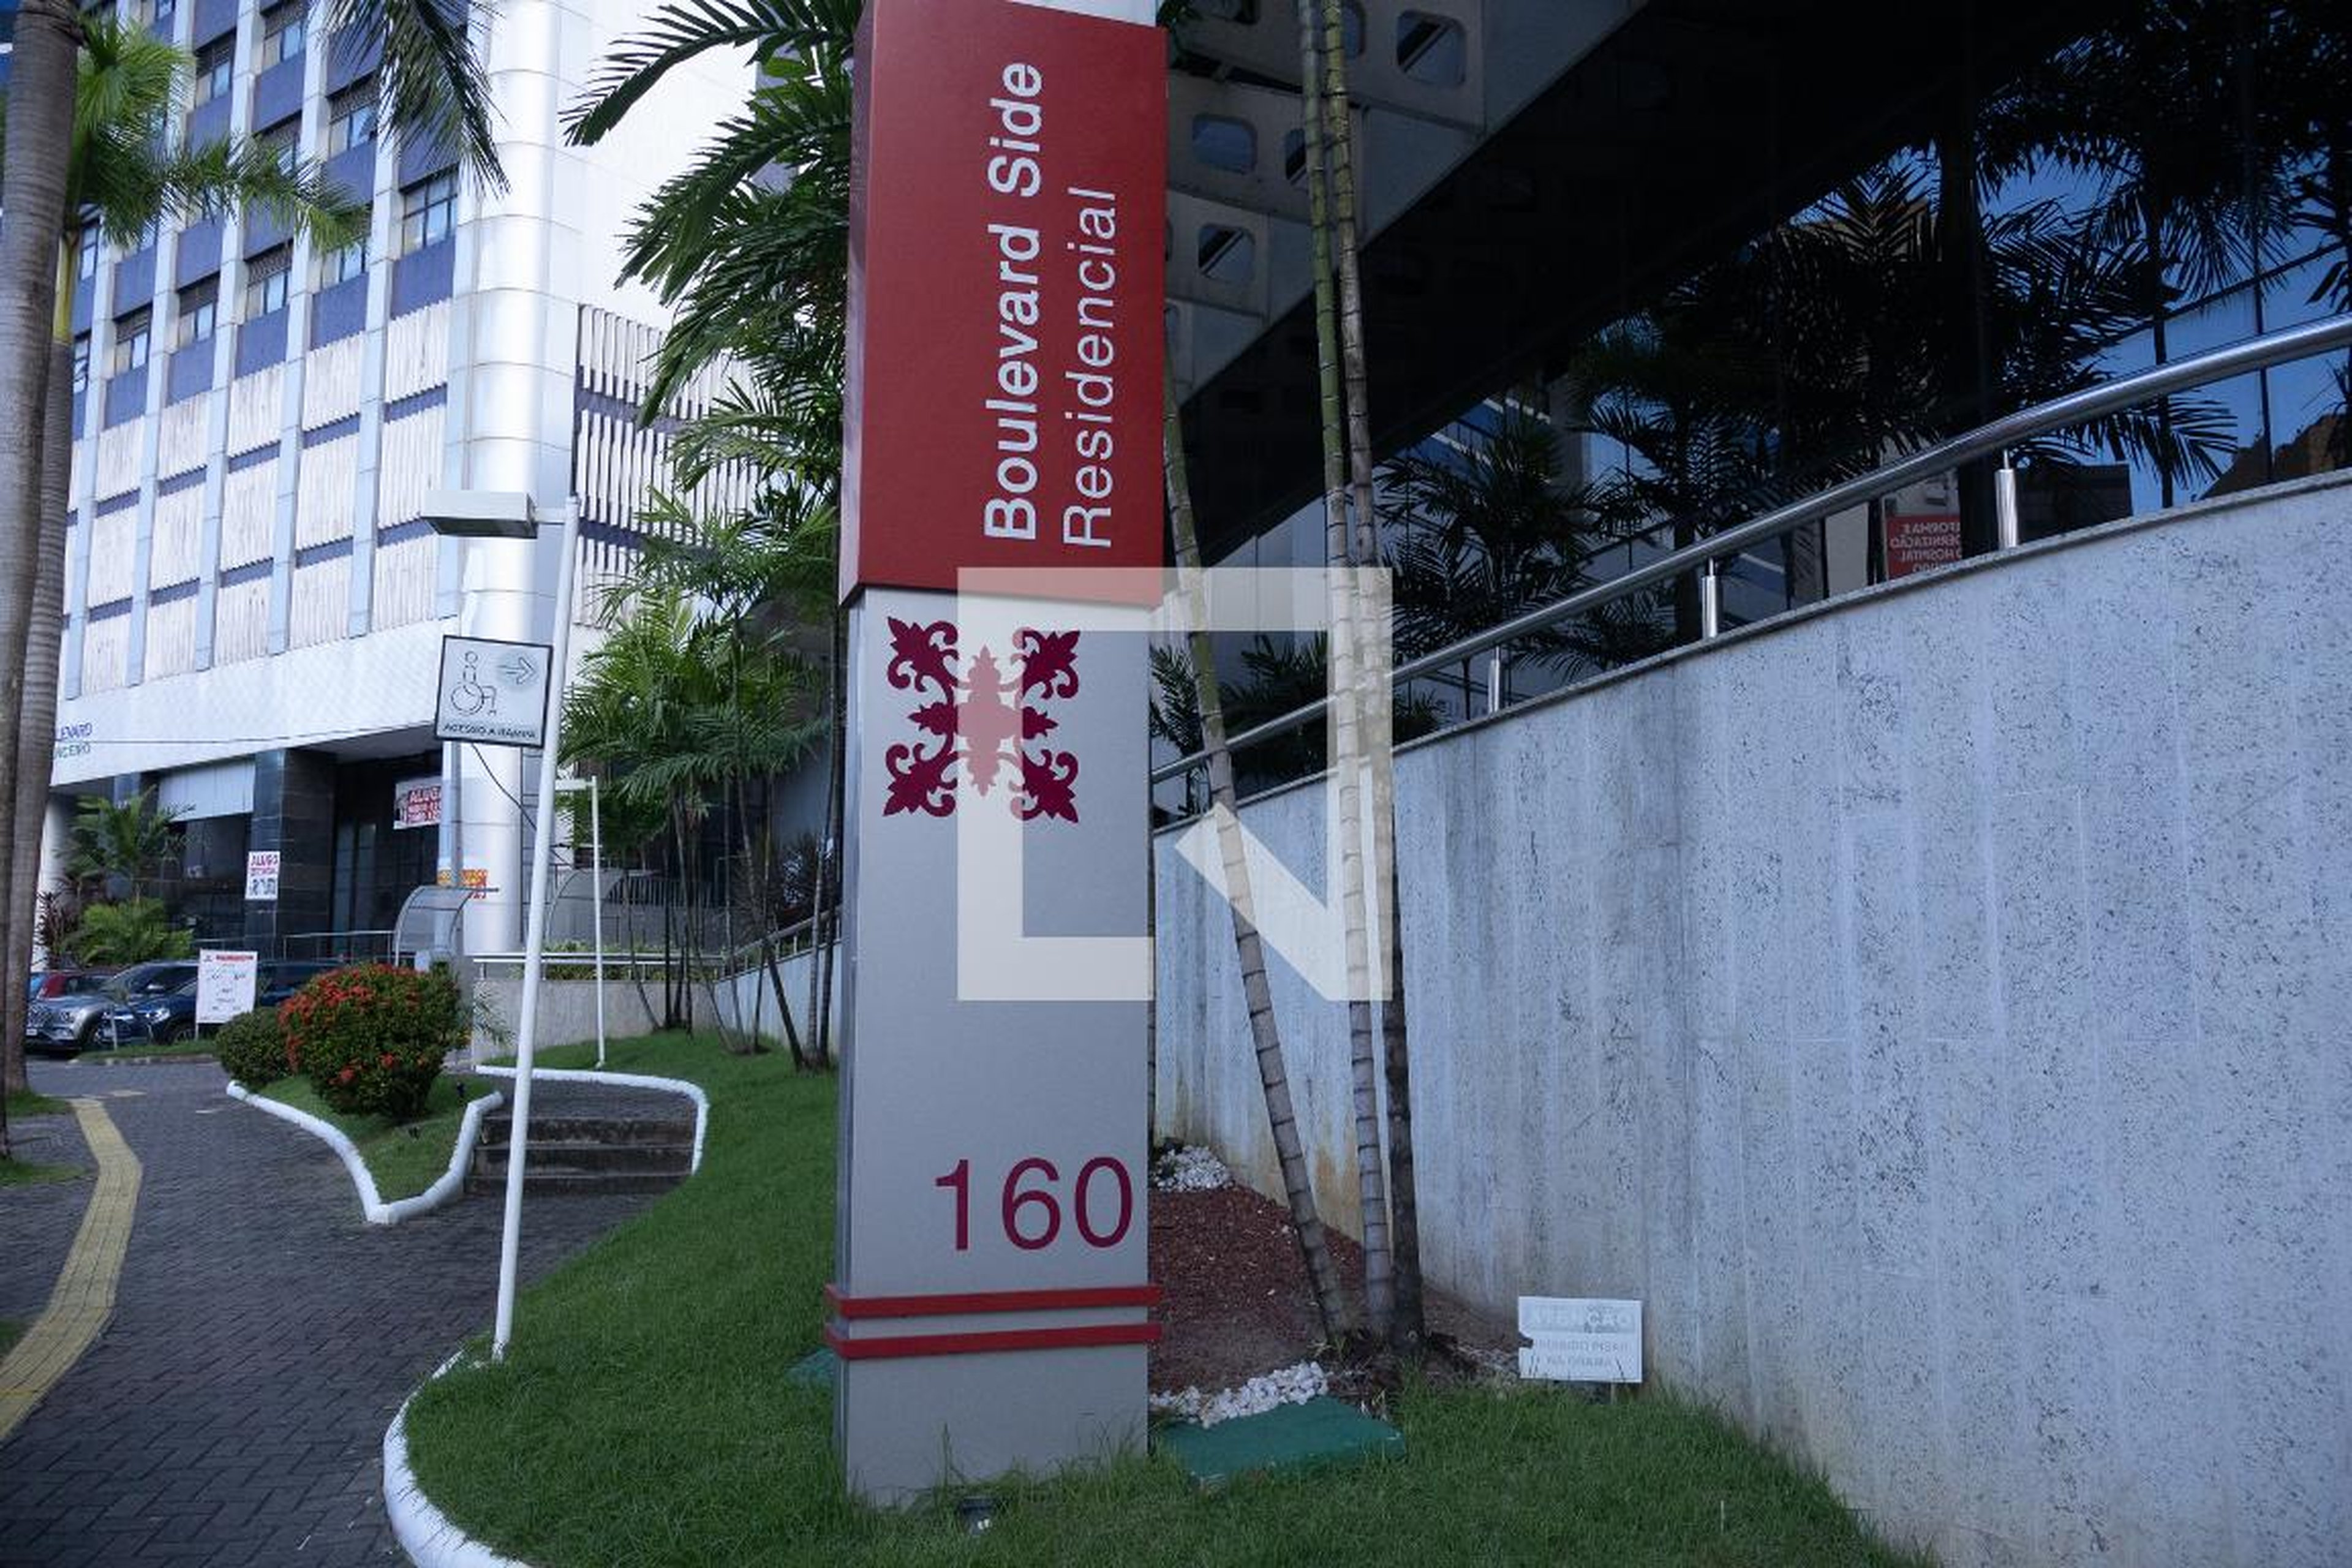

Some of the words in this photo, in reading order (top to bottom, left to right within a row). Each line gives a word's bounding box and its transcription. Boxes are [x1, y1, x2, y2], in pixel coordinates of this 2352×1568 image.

[987, 62, 1042, 197] Side
[983, 223, 1040, 540] Boulevard
[1063, 187, 1116, 547] Residencial
[935, 1156, 1133, 1251] 160
